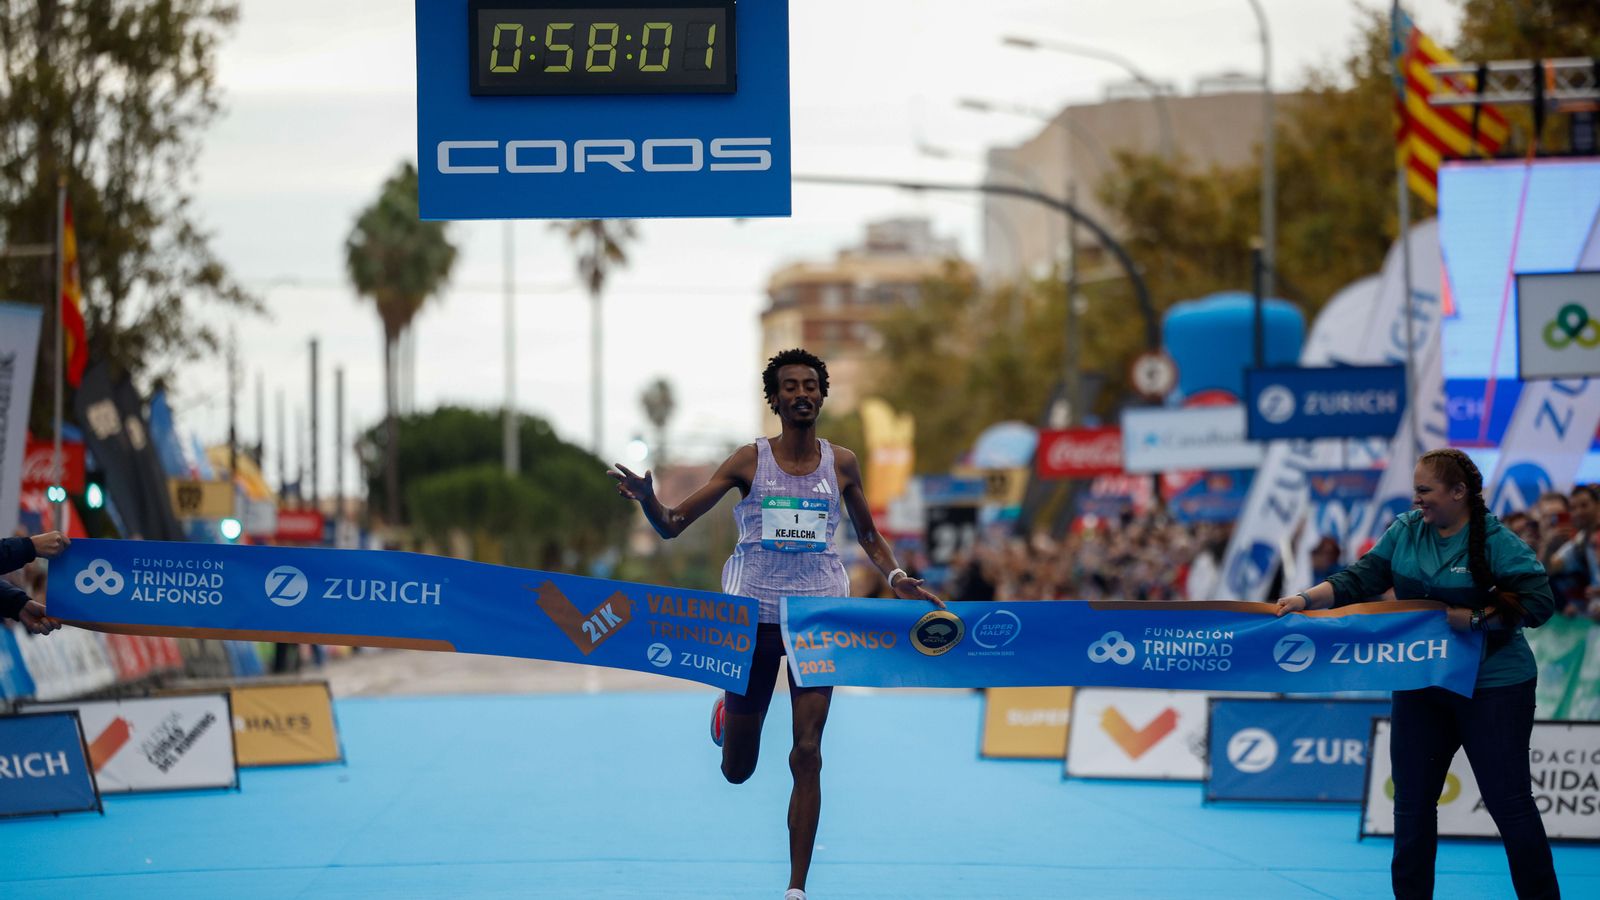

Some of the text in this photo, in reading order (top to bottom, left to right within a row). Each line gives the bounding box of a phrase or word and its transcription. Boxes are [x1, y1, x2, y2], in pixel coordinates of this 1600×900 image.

[489, 22, 716, 73] 0:58:01
[437, 137, 772, 174] COROS
[1303, 390, 1397, 416] ZURICH
[794, 513, 799, 524] 1
[775, 529, 816, 539] KEJELCHA
[133, 558, 224, 571] FUNDACIÓN
[132, 570, 224, 589] TRINIDAD
[130, 588, 223, 606] ALFONSO
[322, 577, 441, 606] ZURICH
[646, 593, 750, 627] VALENCIA
[581, 602, 622, 644] 21K
[1144, 628, 1234, 639] FUNDACIÓN
[649, 621, 751, 652] TRINIDAD
[795, 630, 897, 651] ALFONSO
[1142, 639, 1233, 658] TRINIDAD
[1330, 639, 1448, 665] ZURICH
[680, 652, 742, 679] ZURICH
[800, 659, 836, 675] 2025
[1141, 657, 1232, 672] ALFONSO
[245, 714, 311, 734] HALFS
[1291, 738, 1365, 765] ZUR
[1530, 770, 1600, 791] NIDA
